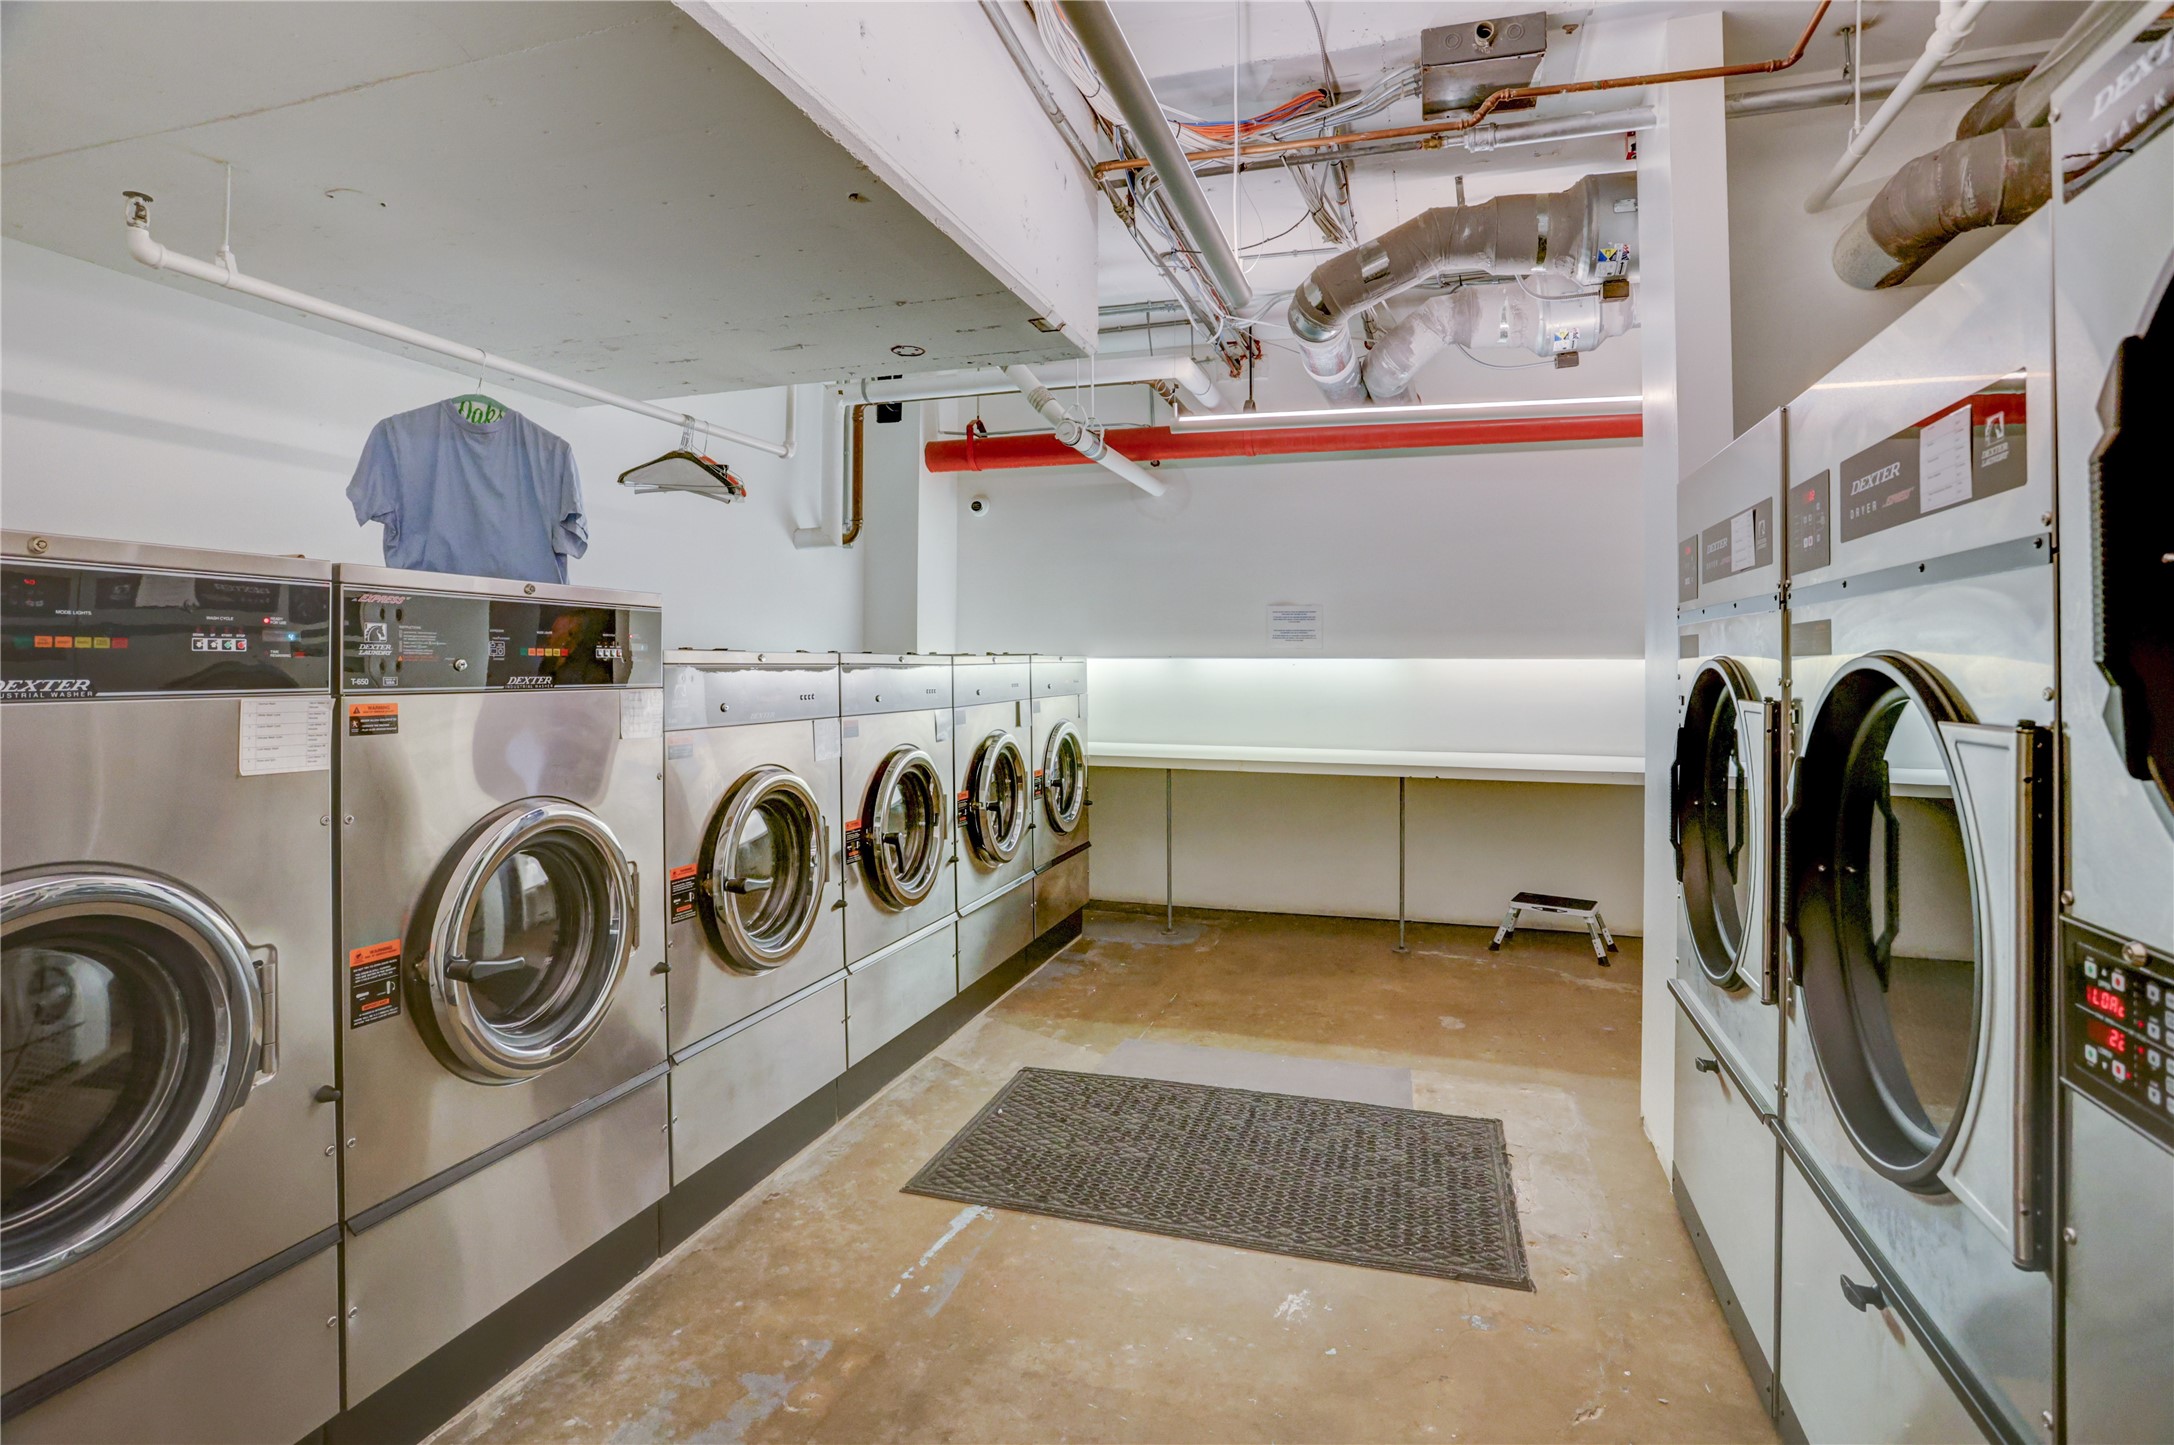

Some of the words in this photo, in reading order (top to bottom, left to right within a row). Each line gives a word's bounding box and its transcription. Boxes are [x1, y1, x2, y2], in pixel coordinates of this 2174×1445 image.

[1850, 461, 1901, 496] DEXTER
[358, 594, 406, 604] EXPRESS
[506, 676, 553, 685] DEXTER
